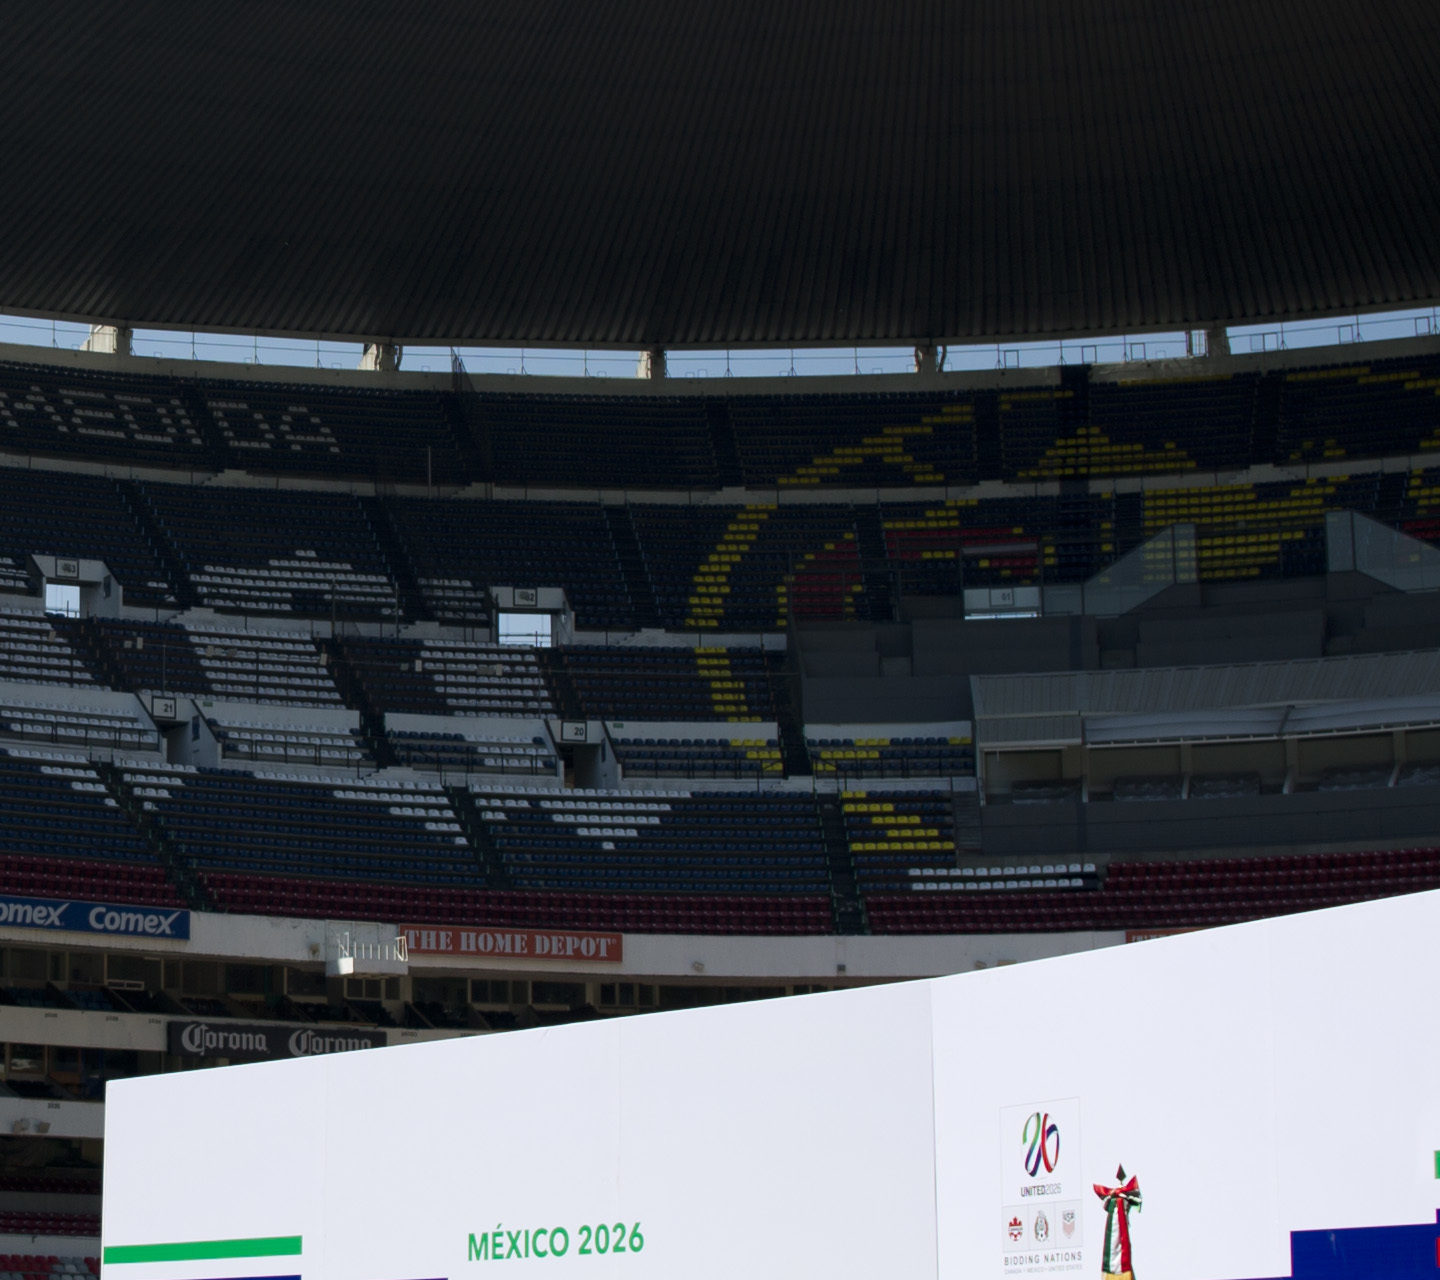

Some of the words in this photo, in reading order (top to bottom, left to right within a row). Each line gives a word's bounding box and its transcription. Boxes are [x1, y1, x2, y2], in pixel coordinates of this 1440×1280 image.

[164, 704, 173, 713] 21
[574, 726, 584, 737] 20
[88, 906, 181, 935] Comex
[405, 929, 453, 951] THE
[460, 931, 528, 955] HOME
[534, 934, 612, 958] DEPOT
[181, 1023, 269, 1056] Corona
[467, 1222, 570, 1263] MÉXICO
[579, 1222, 644, 1257] 2026
[1004, 1254, 1041, 1267] BIDDING
[1043, 1251, 1083, 1264] NATIONS
